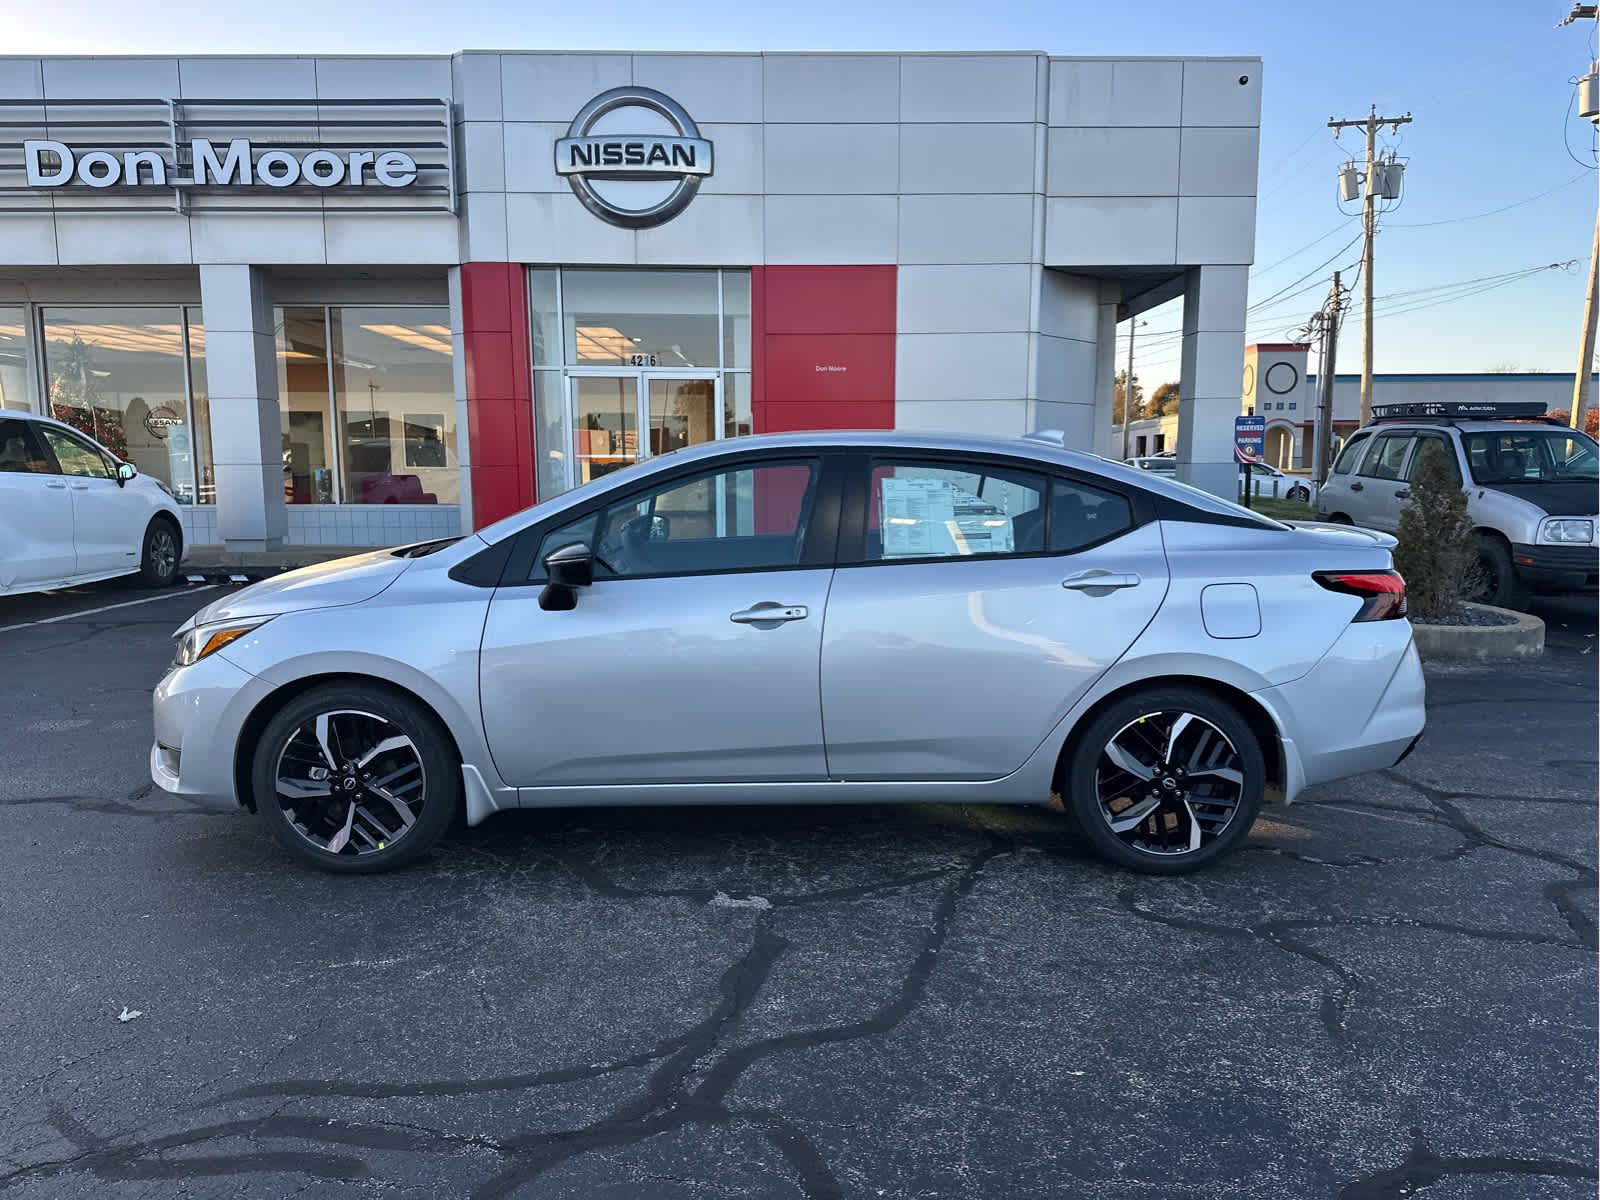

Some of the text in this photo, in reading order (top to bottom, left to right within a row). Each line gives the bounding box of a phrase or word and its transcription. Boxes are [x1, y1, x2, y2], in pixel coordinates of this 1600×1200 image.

[23, 138, 418, 188] Don Moore
[570, 142, 696, 167] NISSAN
[630, 354, 657, 367] 4216
